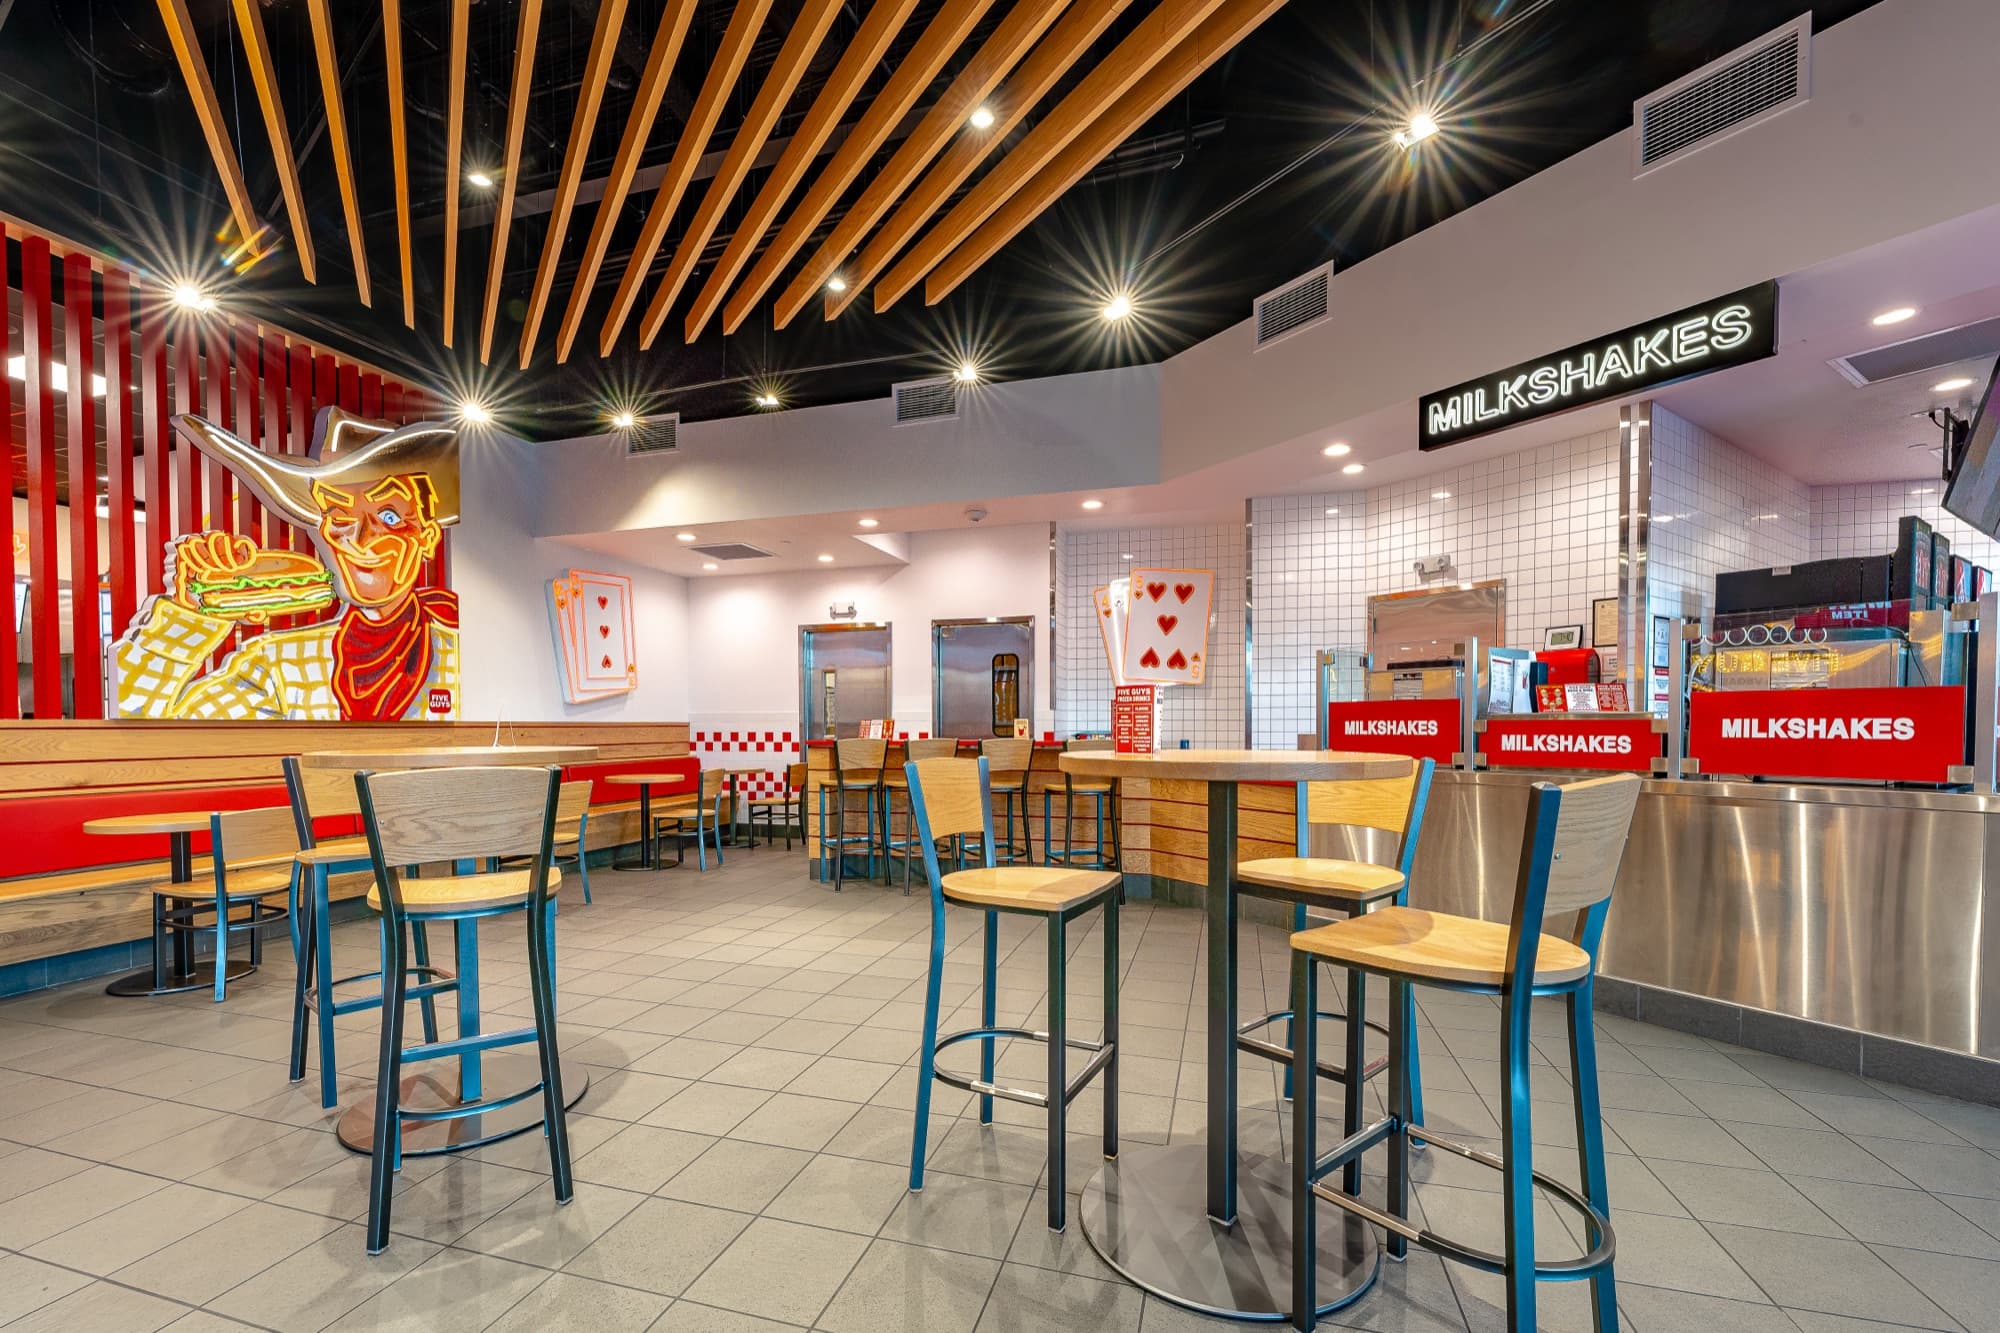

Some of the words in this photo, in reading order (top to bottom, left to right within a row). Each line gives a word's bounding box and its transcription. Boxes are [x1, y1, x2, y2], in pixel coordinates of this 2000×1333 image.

[1428, 304, 1752, 434] MILKSHAKES
[1131, 687, 1151, 695] GUYS
[1344, 719, 1438, 736] MILKSHAKES
[1721, 717, 1915, 741] MILKSHAKES
[1501, 734, 1632, 754] MILKSHAKES
